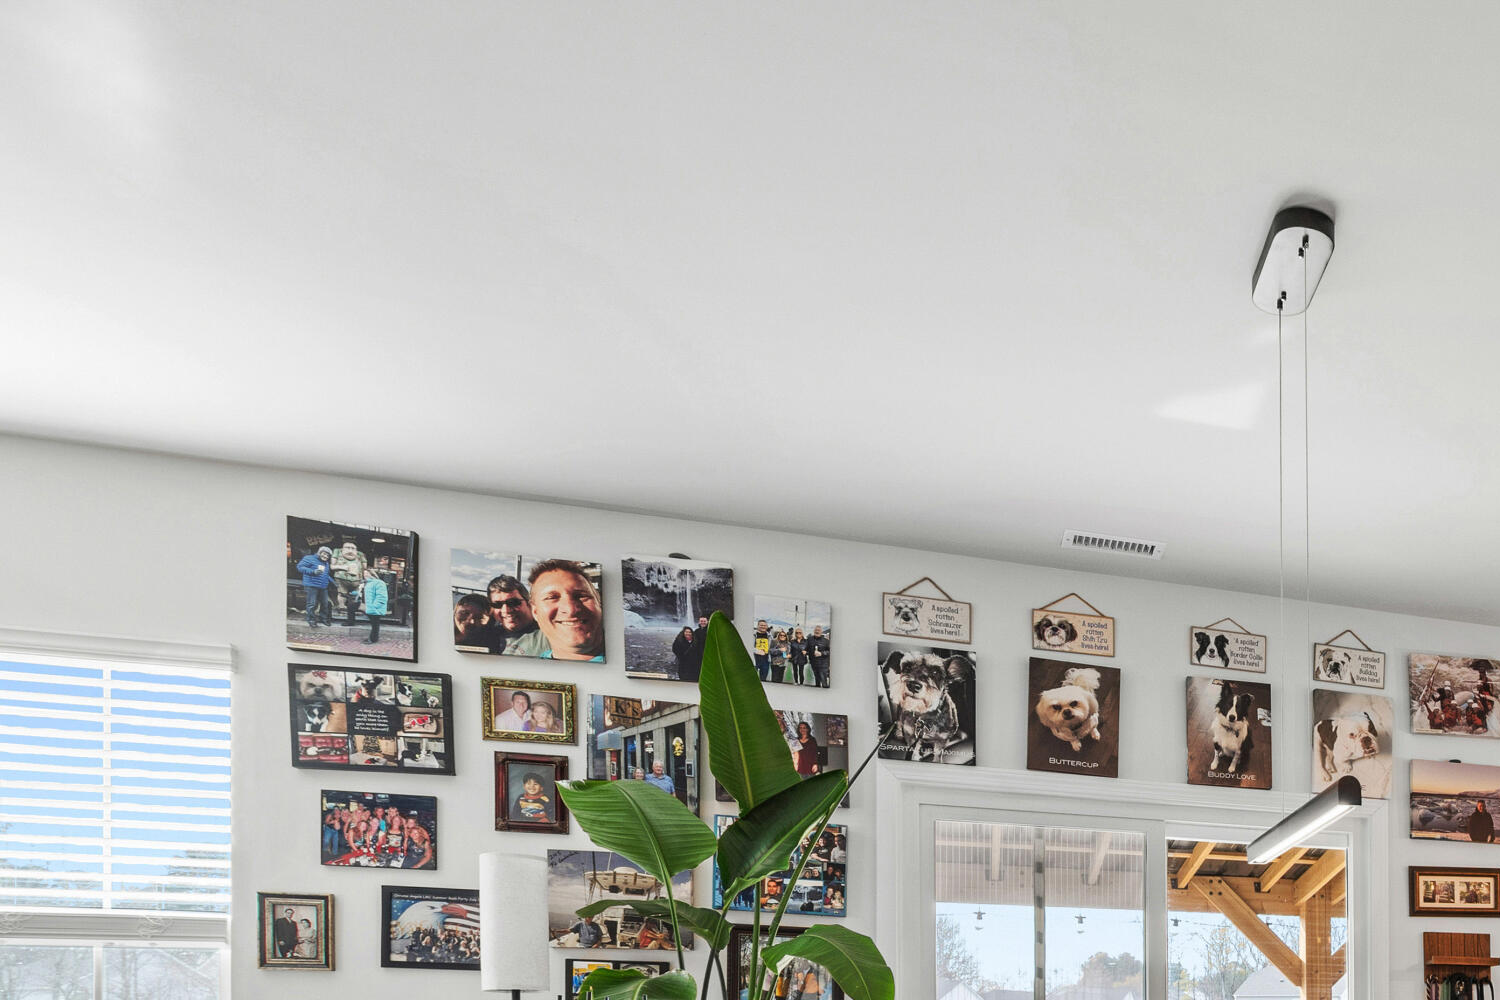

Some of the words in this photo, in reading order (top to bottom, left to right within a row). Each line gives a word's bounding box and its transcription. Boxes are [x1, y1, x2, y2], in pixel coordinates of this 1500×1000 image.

[936, 606, 959, 614] spoiled
[928, 619, 962, 629] Schnauzer
[944, 628, 960, 636] here!
[1082, 634, 1095, 642] Shih
[1360, 668, 1378, 677] Bulldog
[1208, 770, 1235, 779] BUDDY
